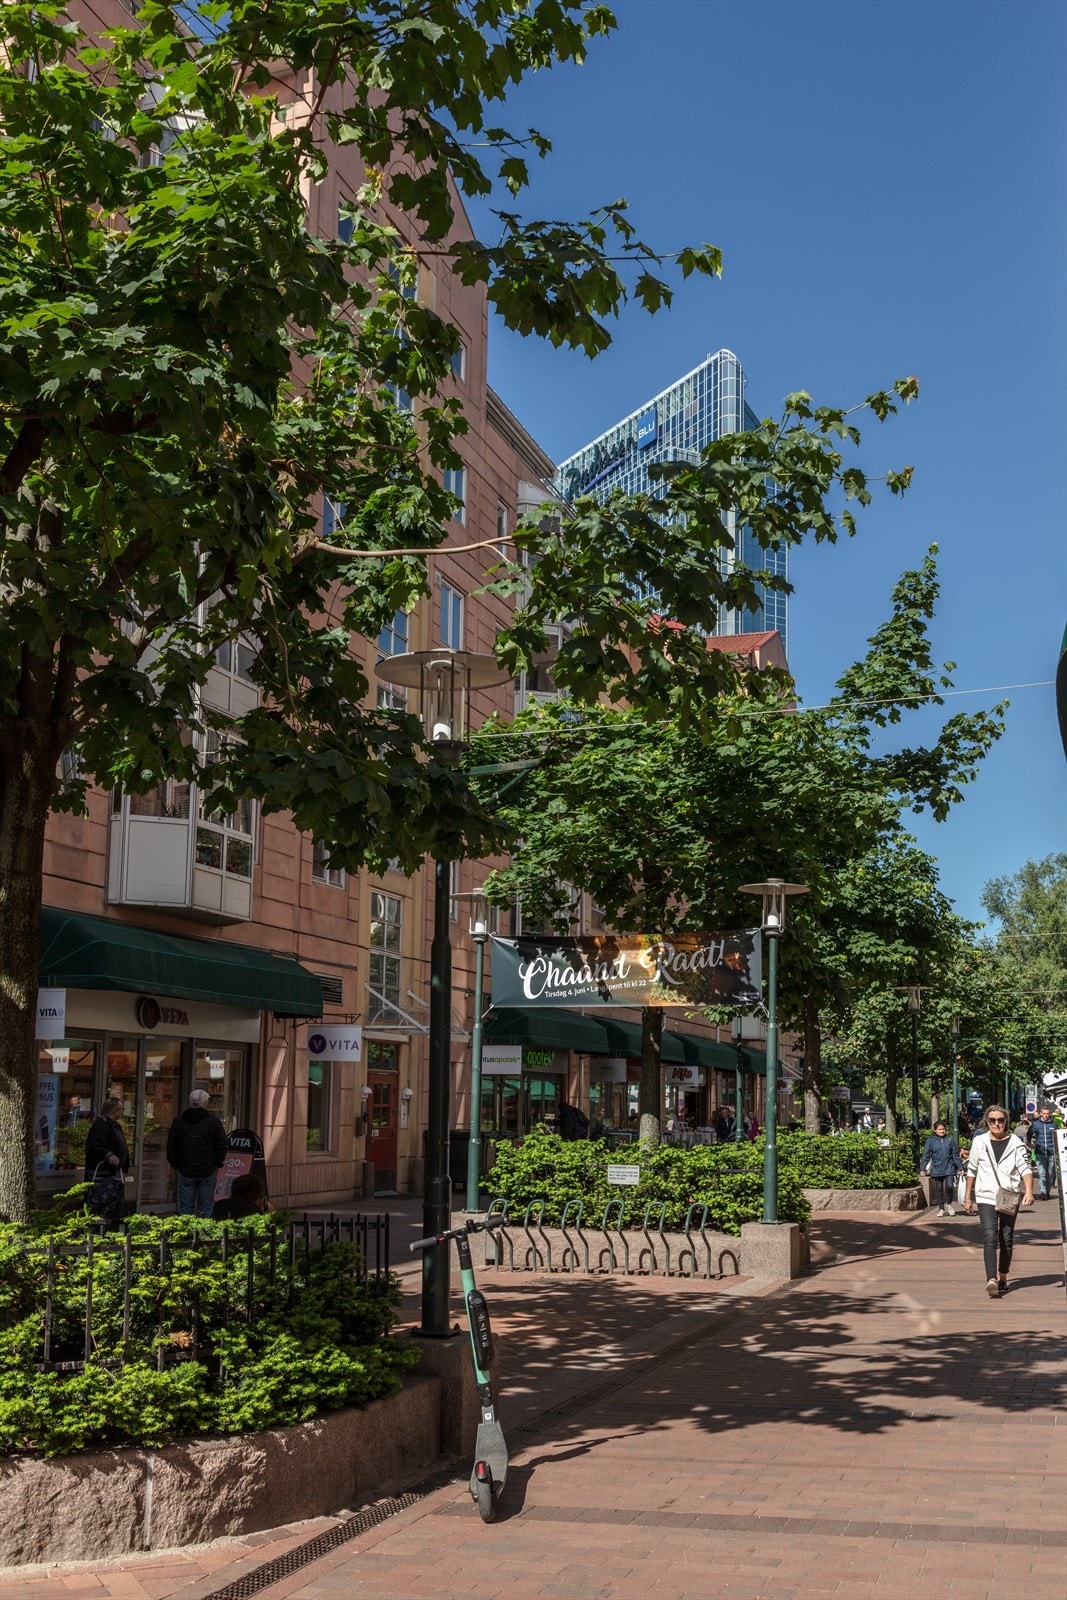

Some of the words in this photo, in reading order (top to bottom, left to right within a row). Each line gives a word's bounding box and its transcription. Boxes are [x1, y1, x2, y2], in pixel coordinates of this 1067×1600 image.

[638, 421, 655, 440] BLU
[519, 953, 631, 999] Chaand
[639, 939, 725, 985] Raat!
[545, 989, 568, 998] Tirsdag
[575, 987, 586, 996] juni
[639, 979, 647, 987] 22
[39, 1008, 58, 1017] VITA
[160, 1007, 190, 1026] VITA
[329, 1040, 360, 1051] VITA
[671, 1067, 693, 1081] Nfe
[229, 1137, 251, 1148] VITA
